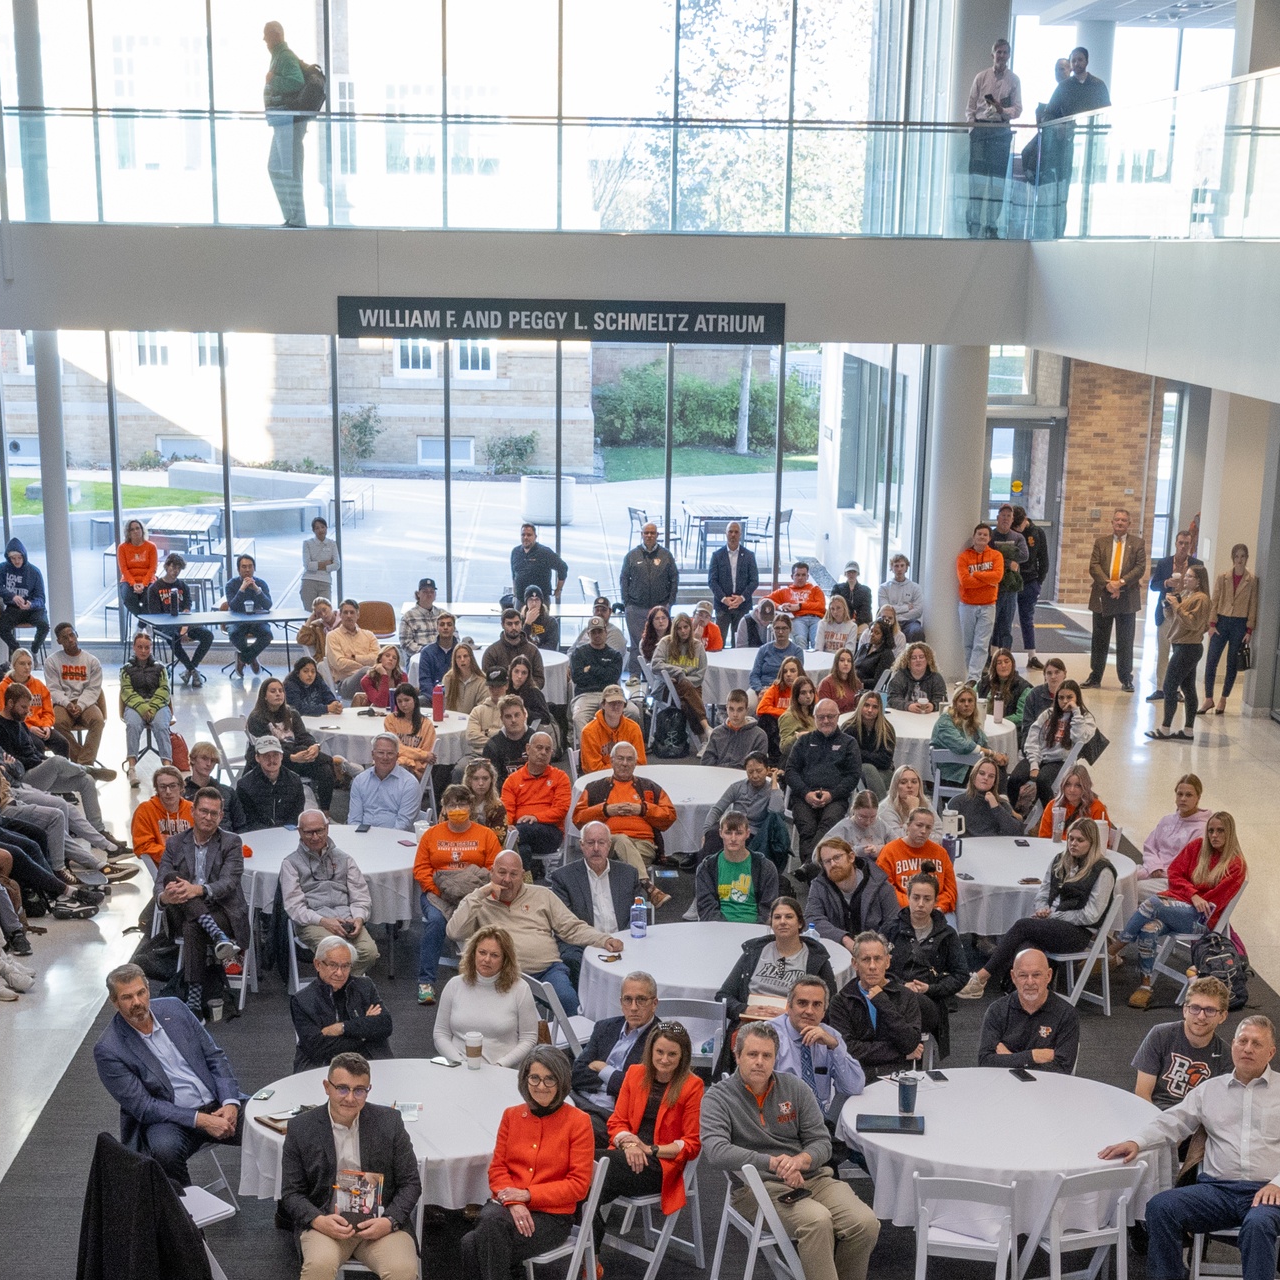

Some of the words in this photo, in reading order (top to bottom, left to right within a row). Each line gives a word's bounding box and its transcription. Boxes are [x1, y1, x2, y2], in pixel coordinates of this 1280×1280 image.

[359, 309, 440, 328] WILLIAM
[446, 311, 457, 328] F.
[462, 311, 502, 329] AND
[509, 311, 567, 329] PEGGY
[574, 312, 588, 330] L.
[593, 312, 689, 332] SCHMELTZ
[694, 314, 765, 333] ATRIUM
[6, 573, 23, 583] LOVE
[6, 580, 16, 588] NO
